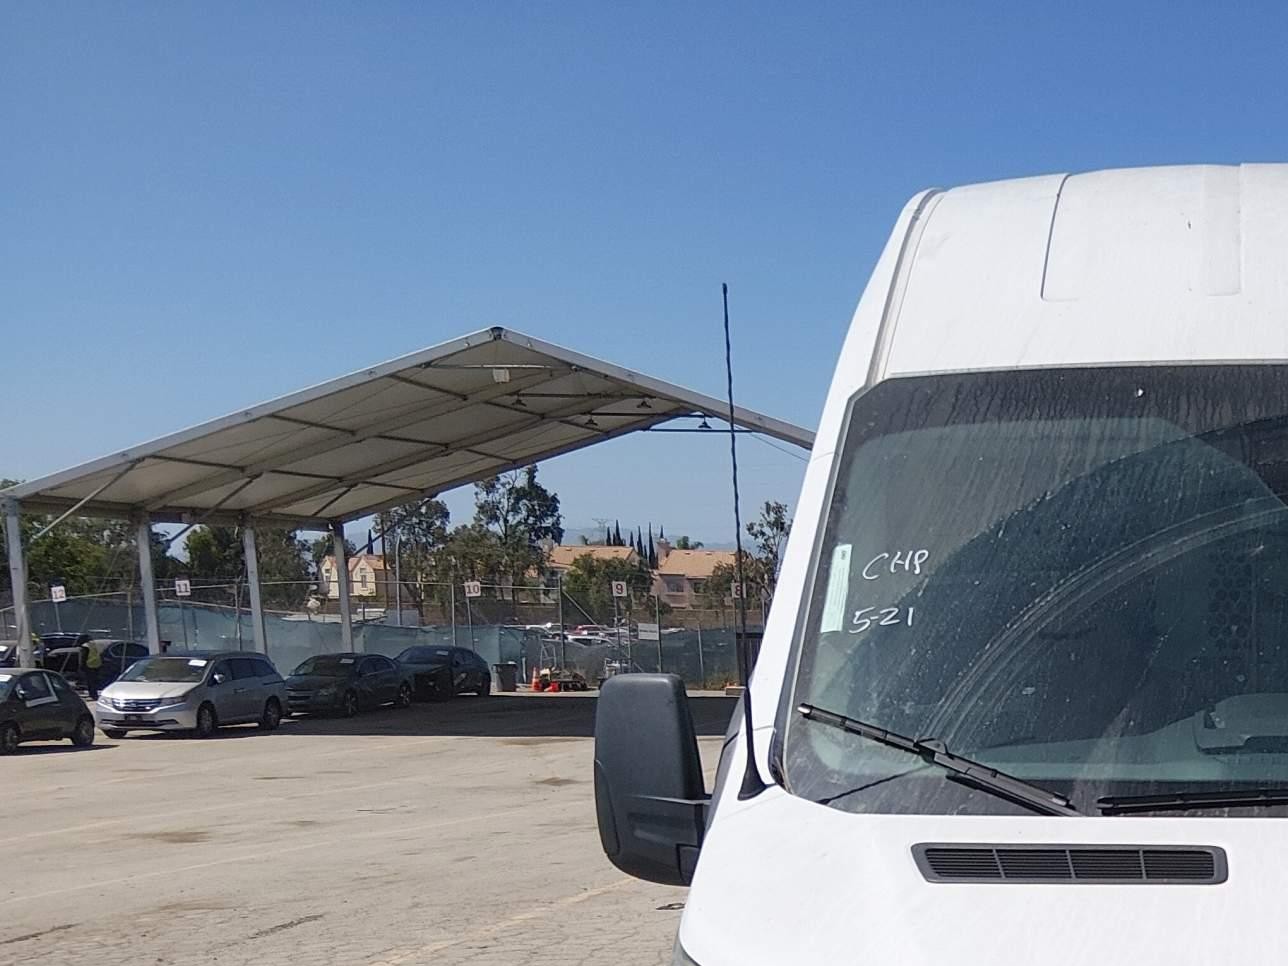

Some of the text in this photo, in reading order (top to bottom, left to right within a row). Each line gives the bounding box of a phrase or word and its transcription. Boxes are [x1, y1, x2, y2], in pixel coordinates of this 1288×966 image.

[176, 583, 189, 594] 11
[466, 584, 480, 594] 10
[615, 583, 624, 595] 9
[52, 589, 66, 600] 12
[849, 606, 914, 634] 5-21
